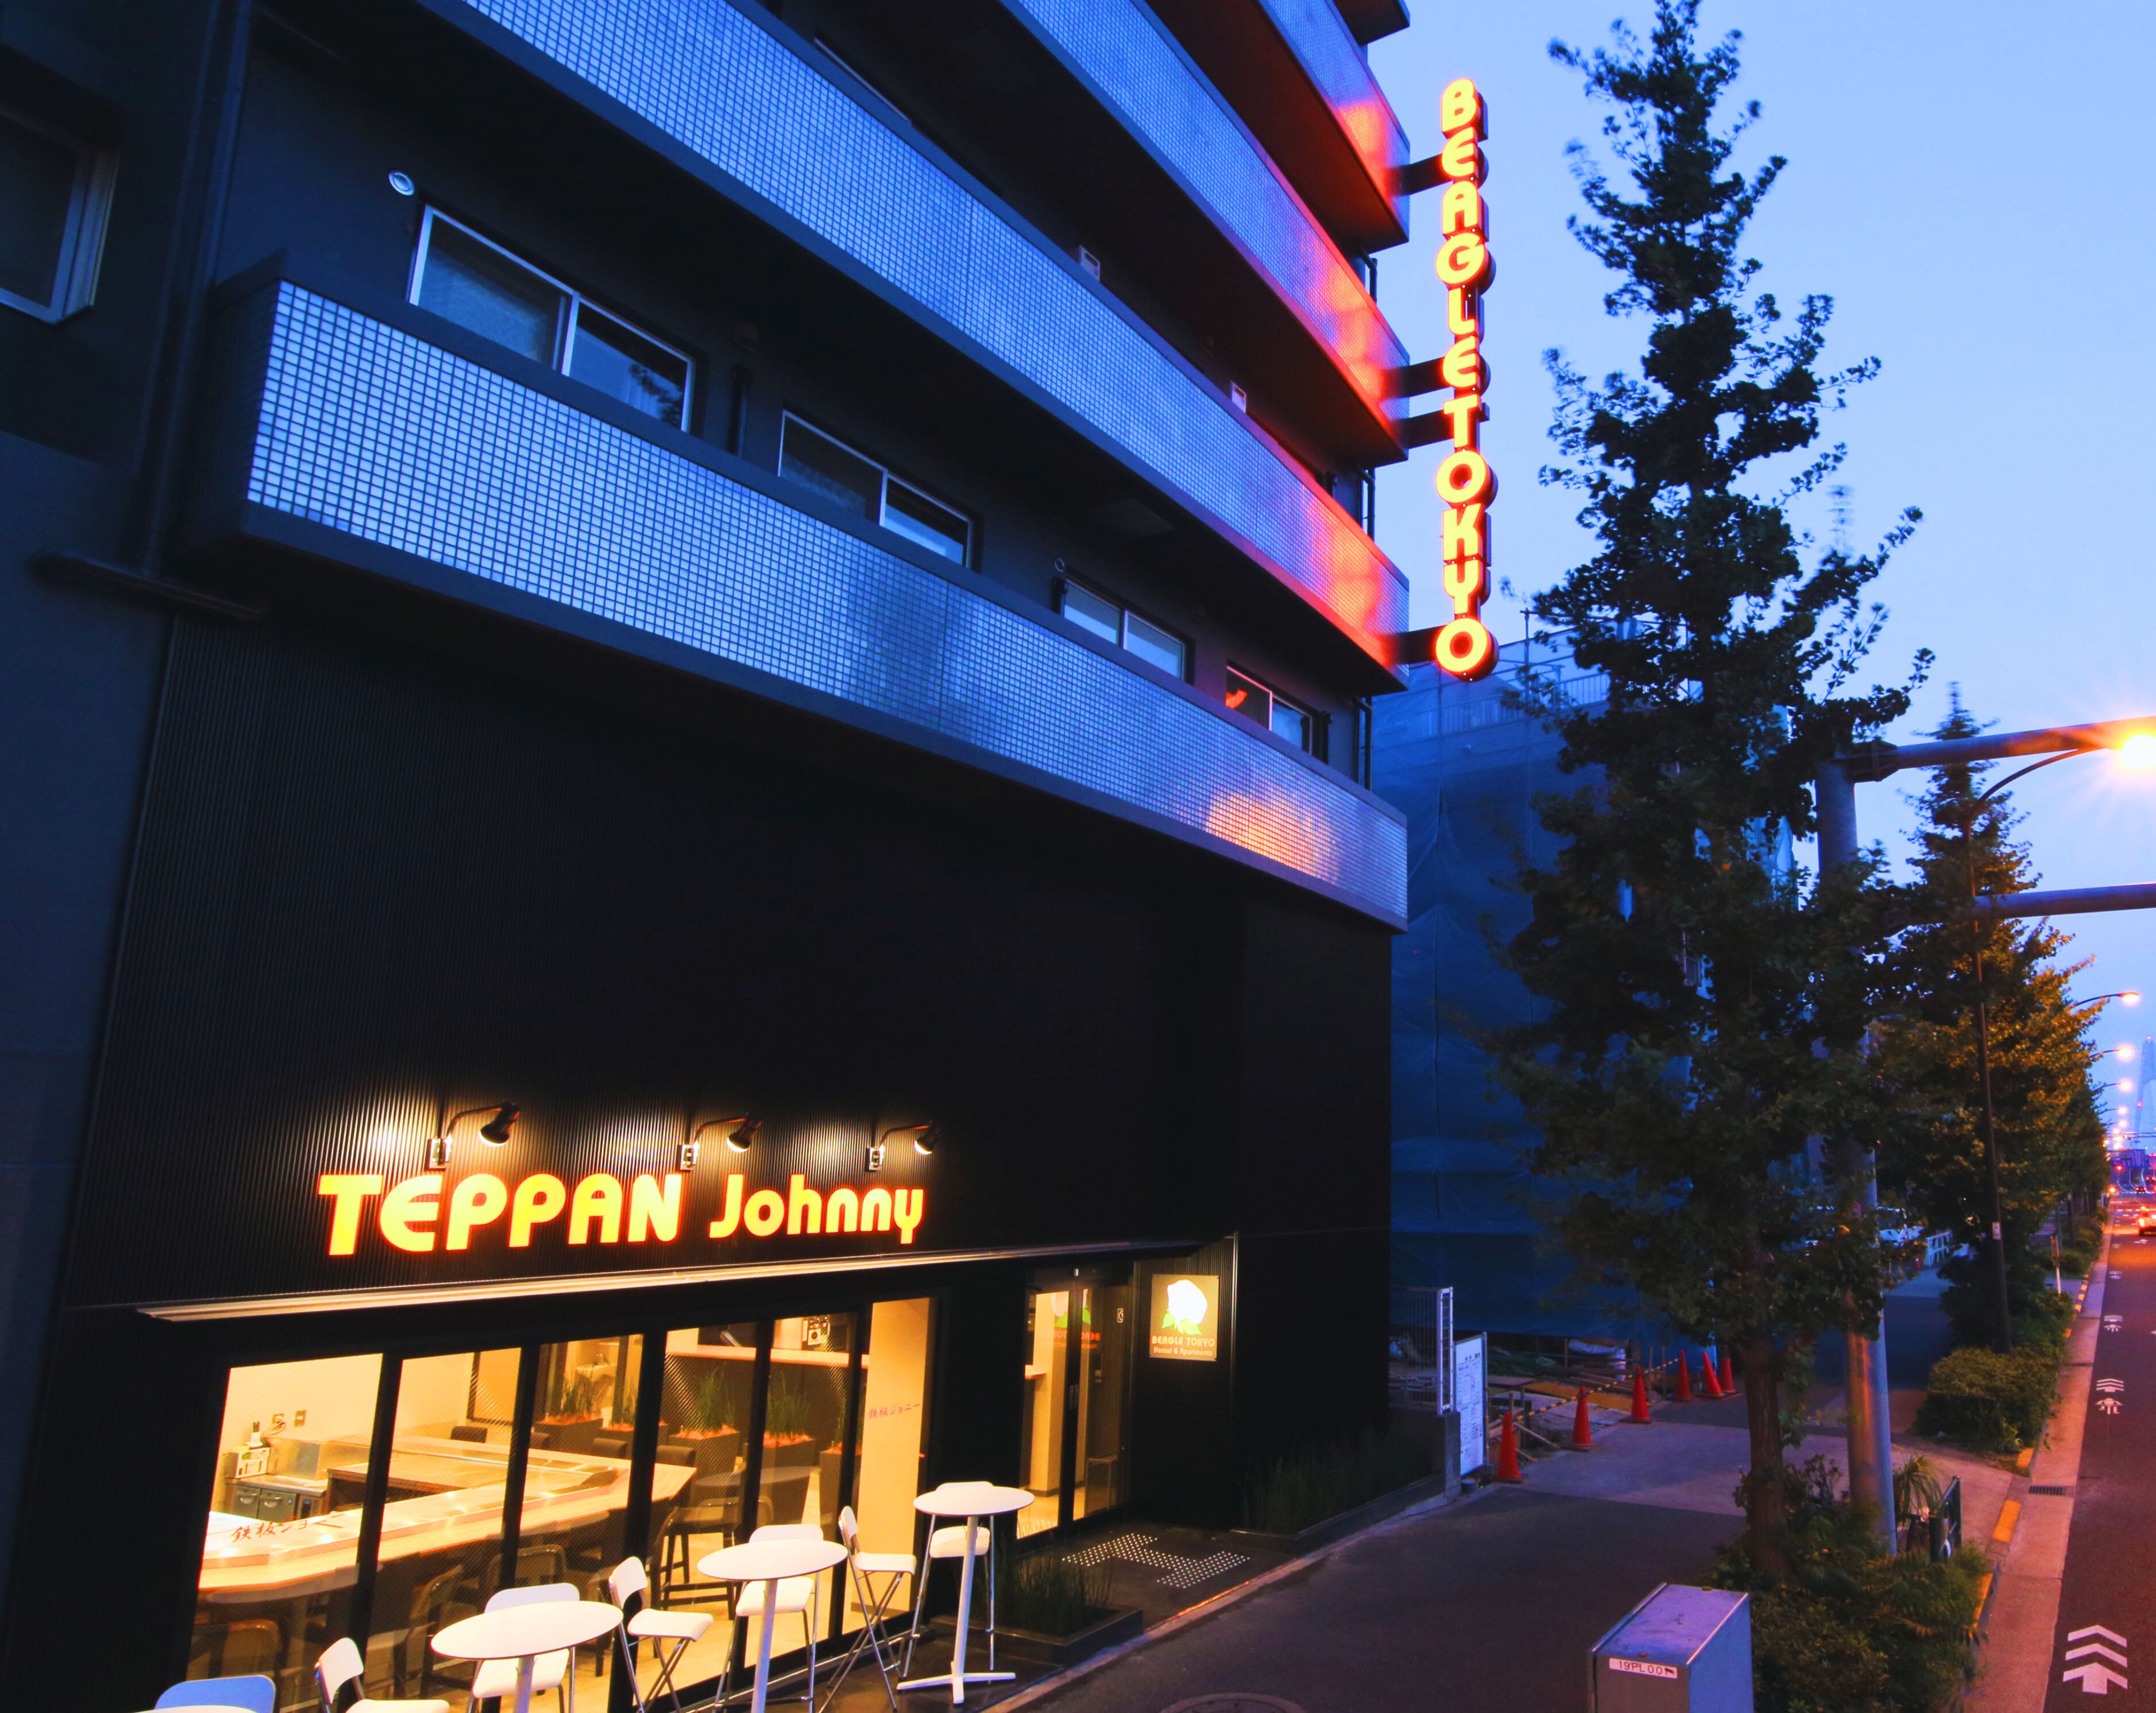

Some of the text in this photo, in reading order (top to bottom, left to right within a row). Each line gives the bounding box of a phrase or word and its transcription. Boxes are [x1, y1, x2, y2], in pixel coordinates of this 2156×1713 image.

[1435, 79, 1488, 673] BEAGLE TOKYO
[318, 1173, 924, 1255] TEPPAN Johnny
[1152, 1336, 1215, 1347] BEAGLE TOKYO
